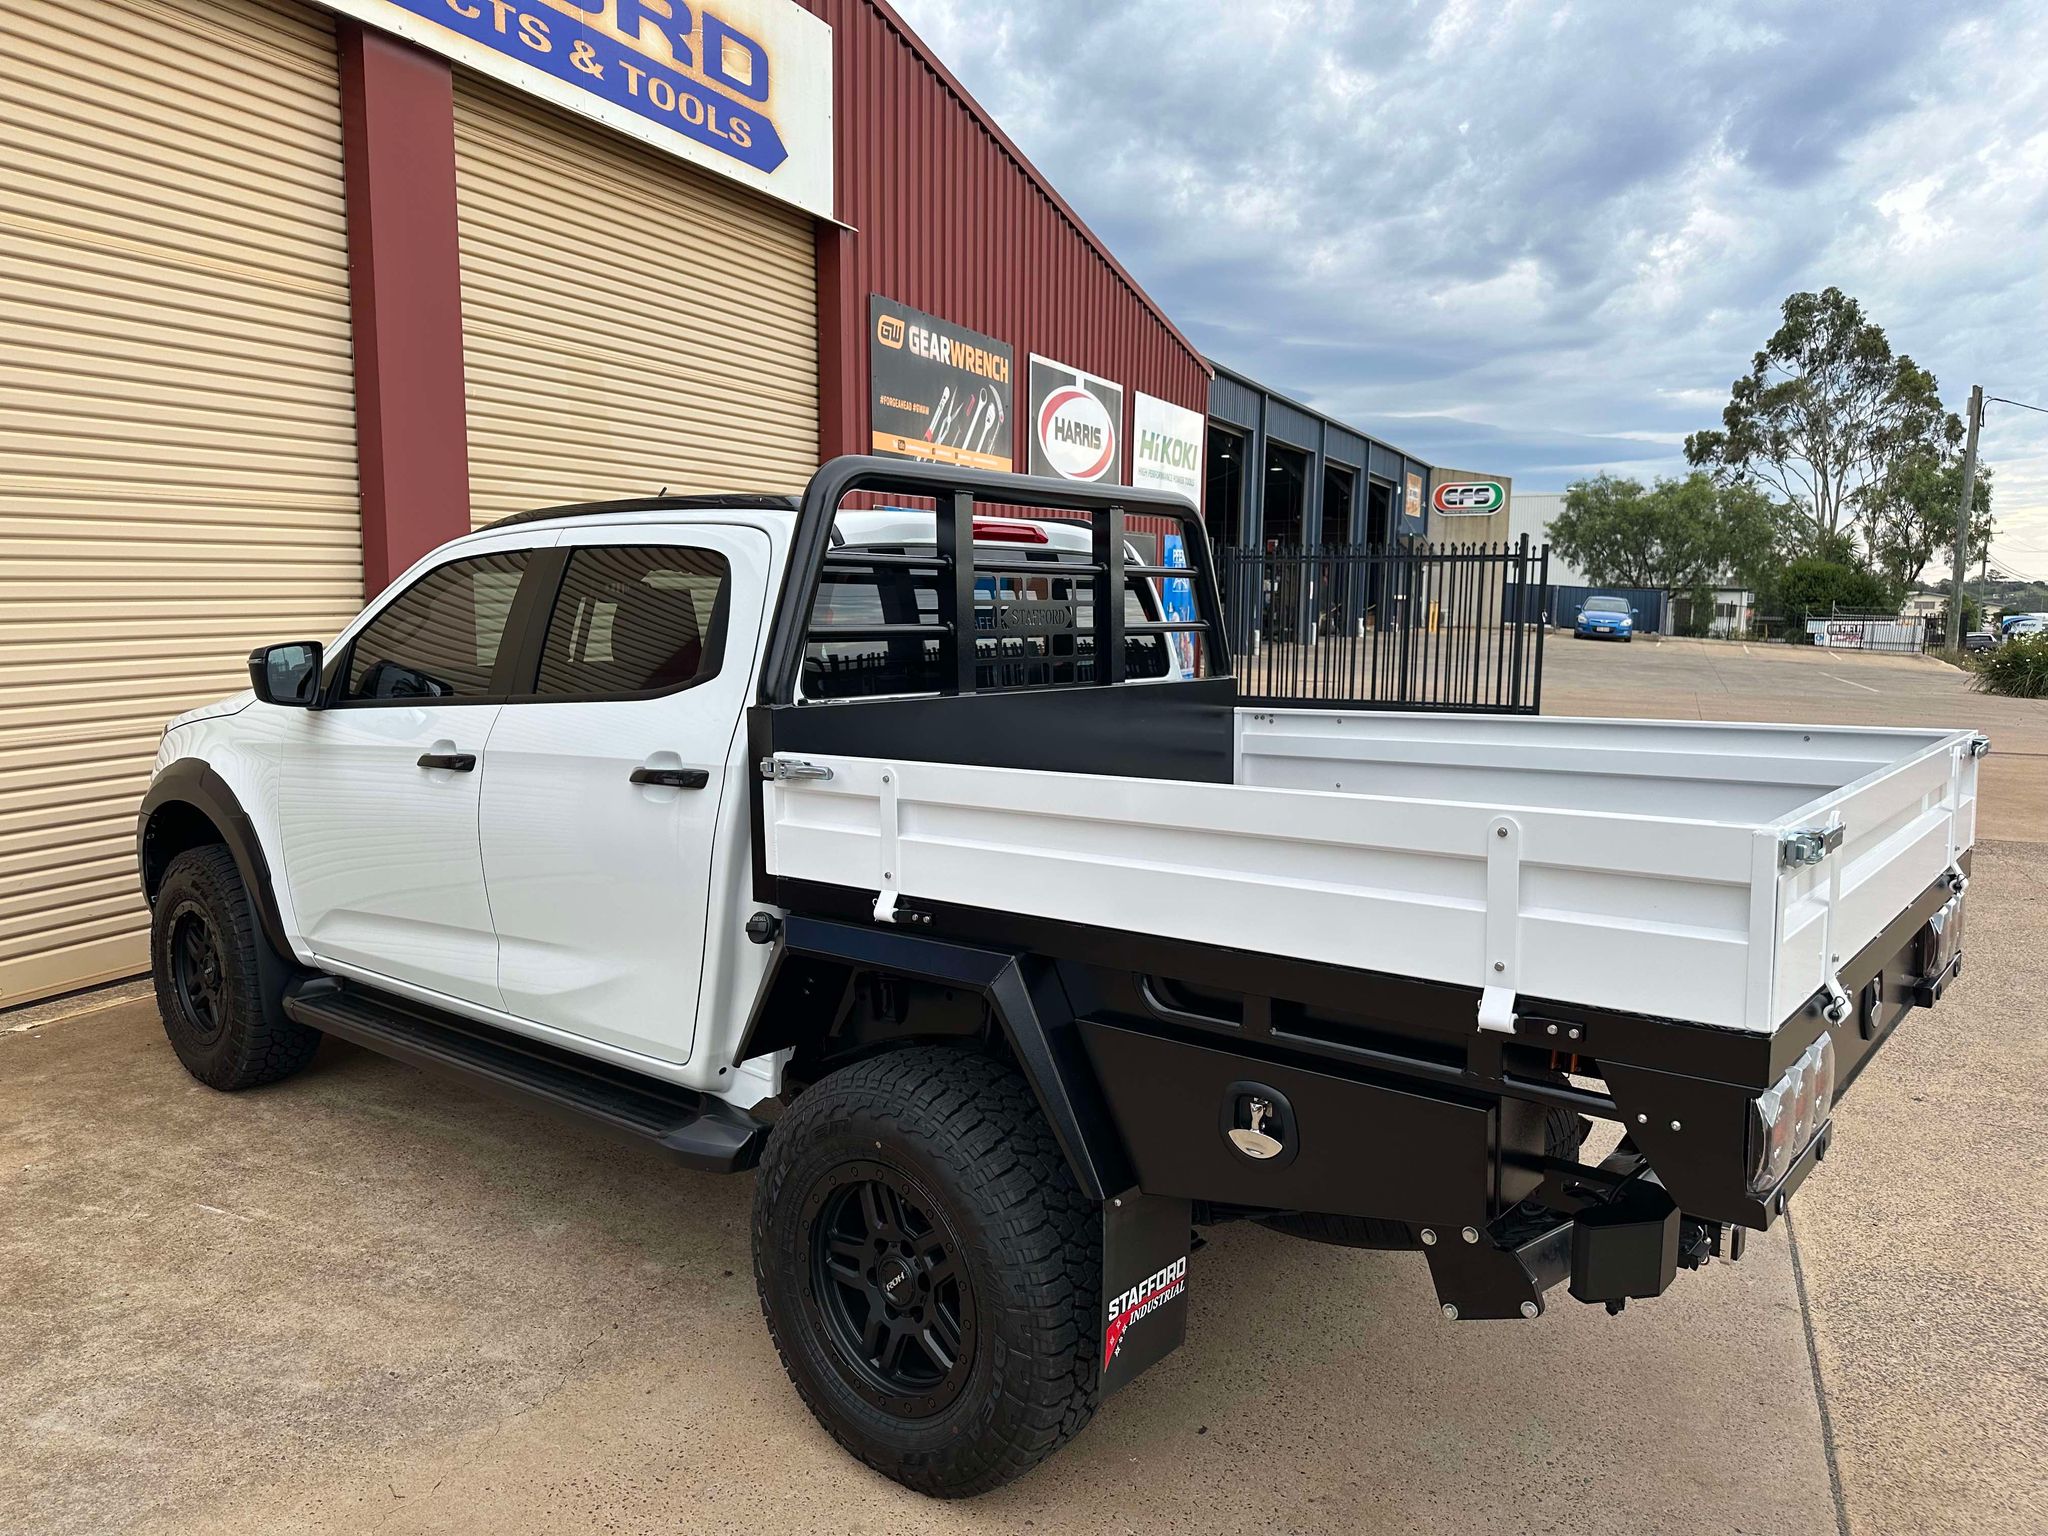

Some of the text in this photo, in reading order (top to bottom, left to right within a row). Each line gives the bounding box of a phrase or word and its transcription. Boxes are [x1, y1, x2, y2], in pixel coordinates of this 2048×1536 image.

[540, 0, 769, 102] RD
[568, 39, 605, 80] &
[618, 60, 752, 148] TOOLS
[908, 325, 1009, 384] GEARWRENCH
[1055, 416, 1101, 450] HARRIS
[1012, 609, 1065, 625] STAFFORD
[886, 1271, 905, 1291] ROH
[1108, 1256, 1187, 1322] STAFFORD
[1129, 1280, 1186, 1326] INDUSTRIAL
